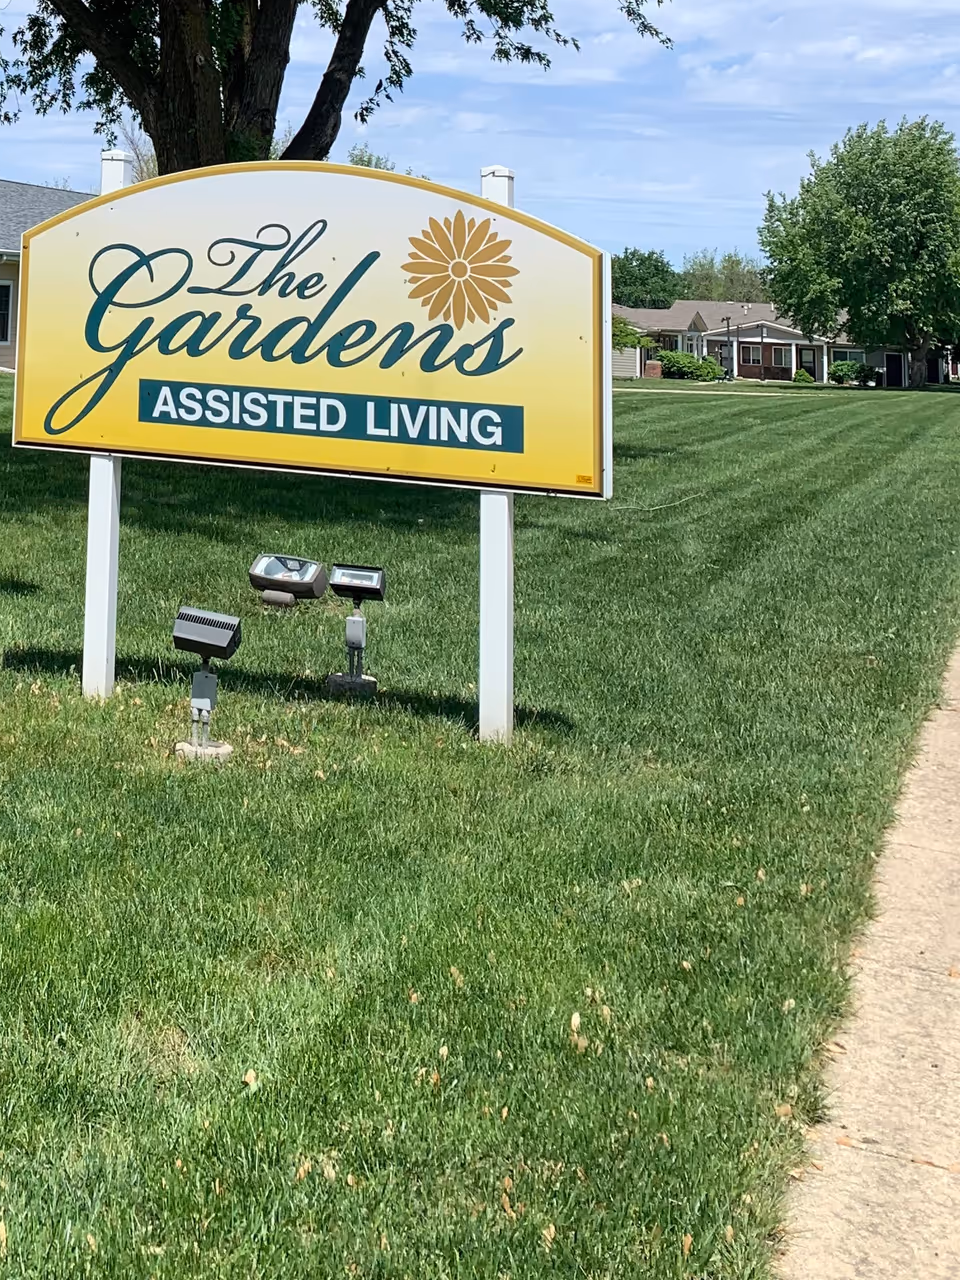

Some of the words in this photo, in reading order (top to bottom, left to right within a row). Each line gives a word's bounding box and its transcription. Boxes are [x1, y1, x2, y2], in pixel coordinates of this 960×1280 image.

[187, 218, 328, 300] The
[44, 243, 524, 435] Gardens
[152, 385, 347, 433] ASSISTED
[367, 401, 503, 446] LIVING
